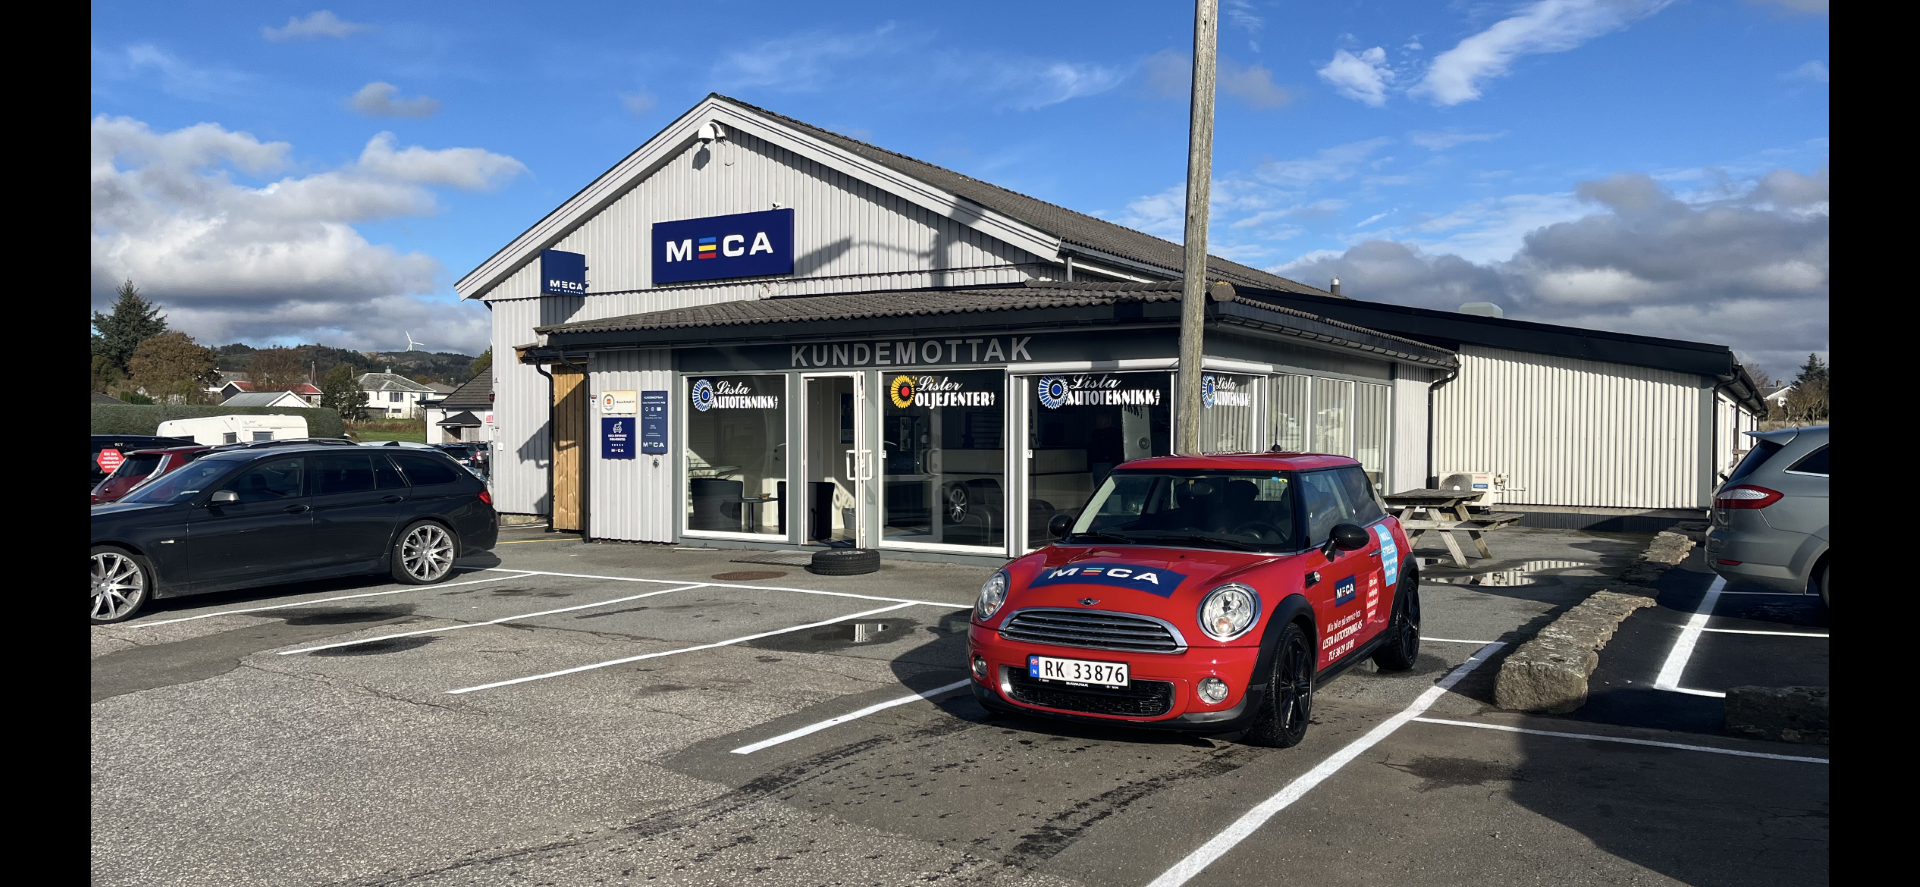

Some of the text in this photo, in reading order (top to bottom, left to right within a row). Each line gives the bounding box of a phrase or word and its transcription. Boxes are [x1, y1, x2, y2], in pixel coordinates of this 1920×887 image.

[666, 232, 774, 263] MECA
[549, 279, 583, 290] MECA
[791, 336, 1032, 367] KUNDEMOTTAK
[714, 380, 751, 395] Lista
[916, 375, 964, 391] Lister
[1069, 374, 1122, 390] Lista
[1216, 374, 1237, 390] Lista
[711, 395, 774, 409] AUTOTEKNIKK
[914, 392, 990, 409] OLJESENTER
[1065, 389, 1155, 406] AUTOTEKNIKK
[1048, 567, 1159, 585] MECA
[1336, 583, 1355, 599] MECA
[1045, 660, 1125, 683] RK 33876
